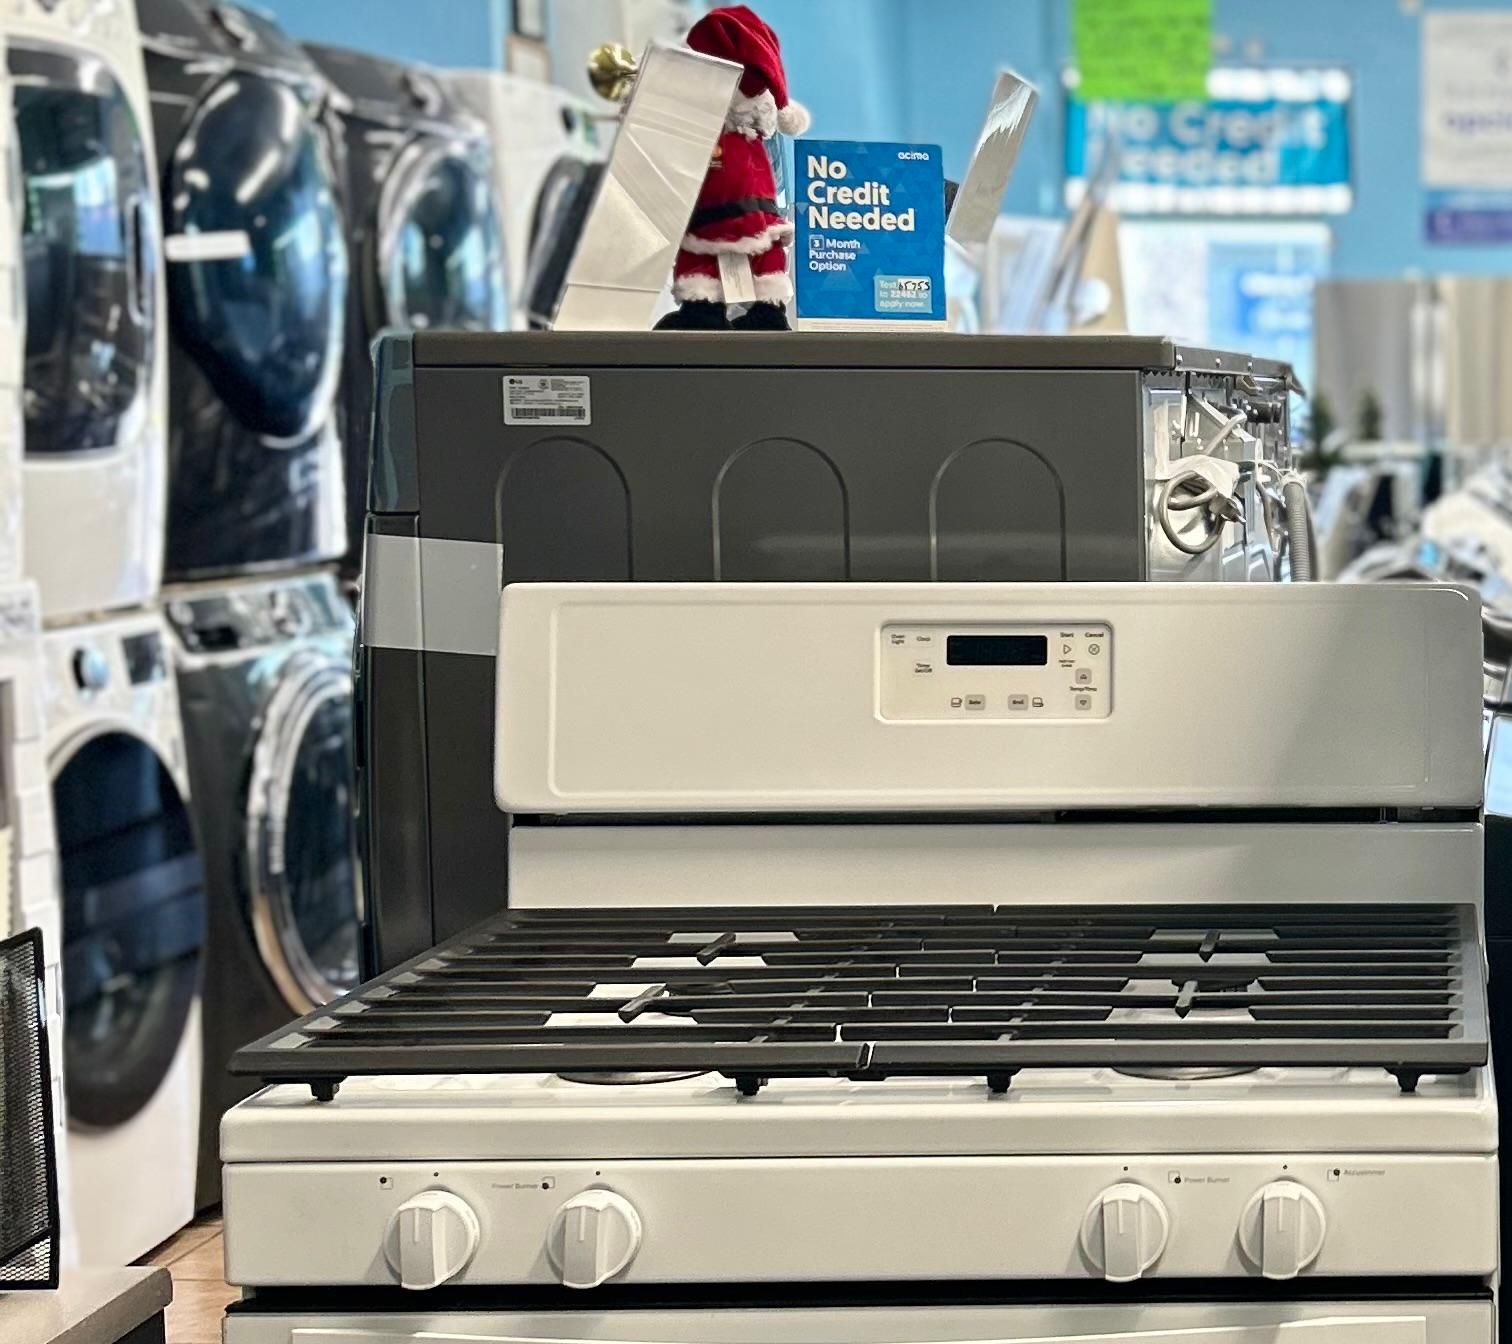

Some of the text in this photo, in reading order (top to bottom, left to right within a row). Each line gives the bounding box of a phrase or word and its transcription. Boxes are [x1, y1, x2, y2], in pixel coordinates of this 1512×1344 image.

[807, 155, 847, 179] No
[807, 181, 890, 206] Credit
[808, 206, 915, 231] Needed
[826, 239, 860, 249] Month
[809, 250, 857, 261] Purchase
[809, 261, 847, 273] Option
